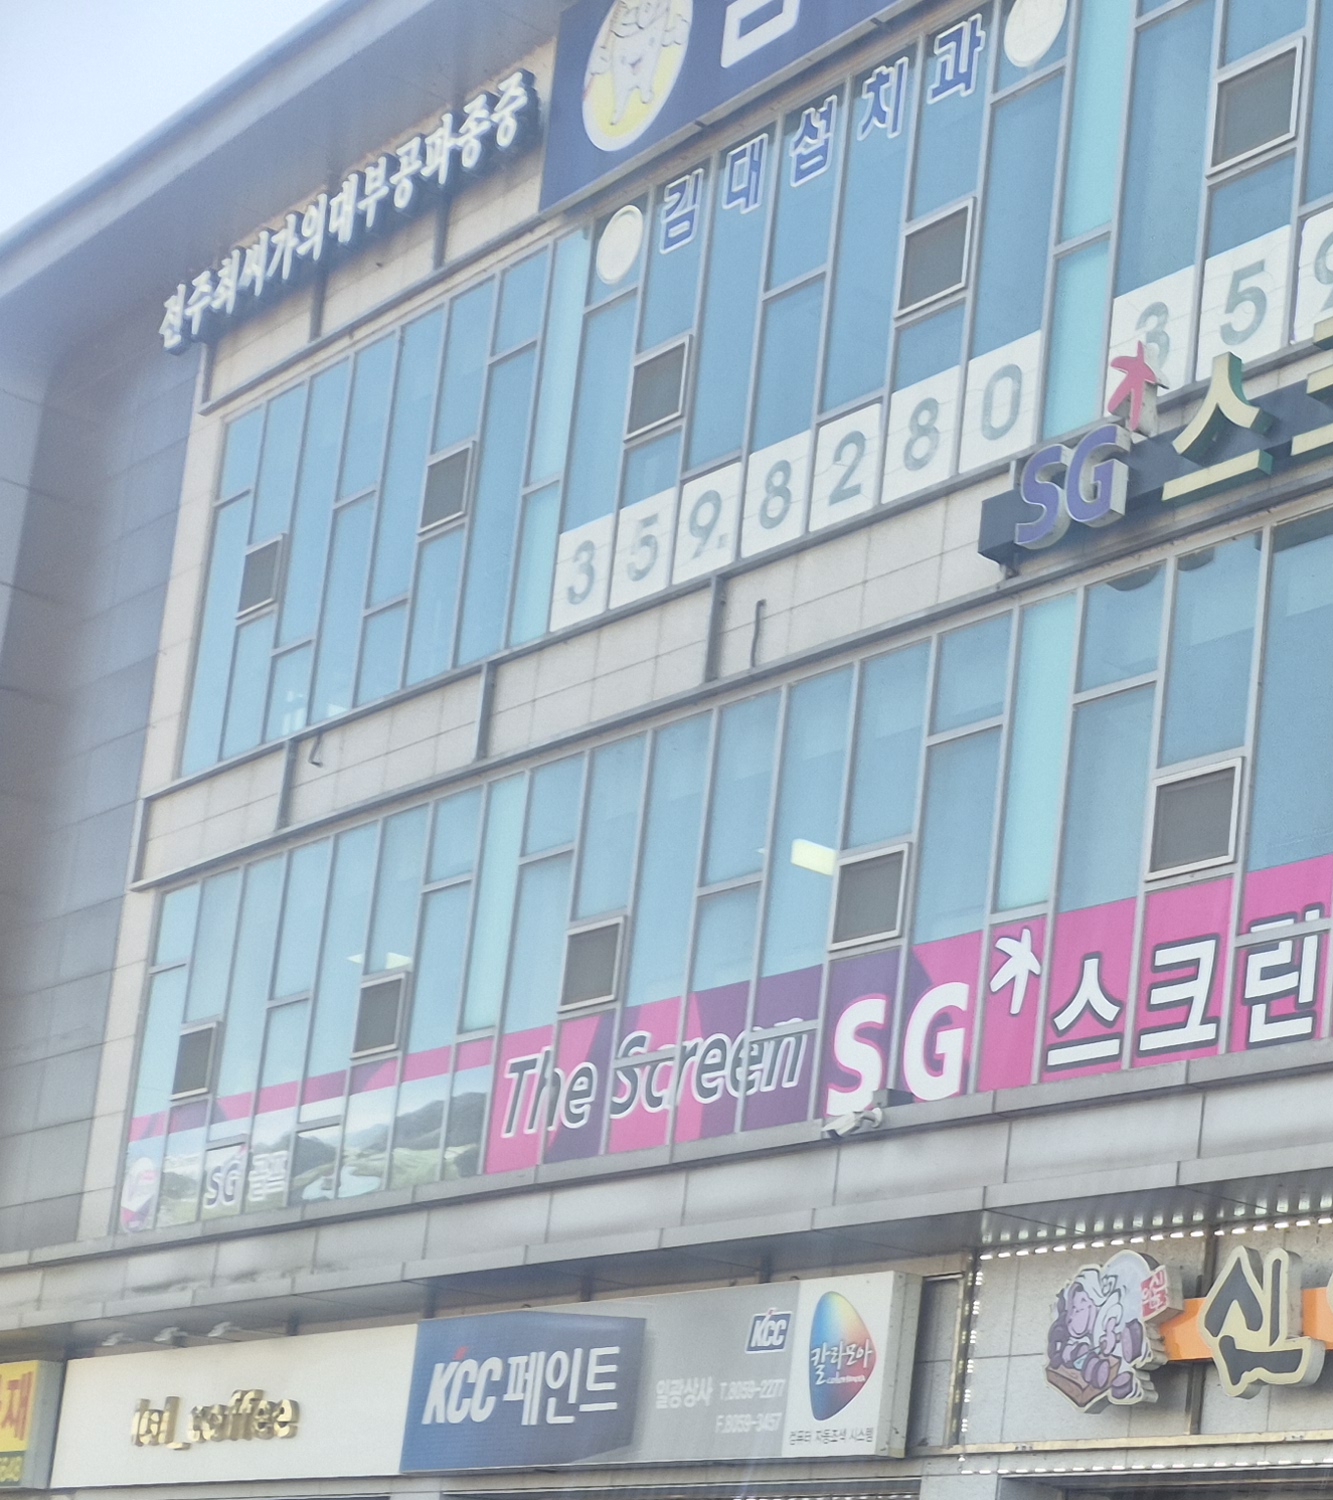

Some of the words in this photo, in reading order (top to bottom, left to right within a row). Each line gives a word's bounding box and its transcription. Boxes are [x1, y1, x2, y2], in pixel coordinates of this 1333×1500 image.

[658, 13, 986, 255] 김대섭치과
[1015, 424, 1132, 548] SG
[500, 1054, 597, 1139] The
[607, 1019, 808, 1120] Screen
[825, 980, 970, 1117] SG
[749, 1316, 788, 1349] KCC
[809, 1338, 876, 1387] 칼라모아
[421, 1347, 502, 1425] KCC
[504, 1346, 621, 1427] 페인트
